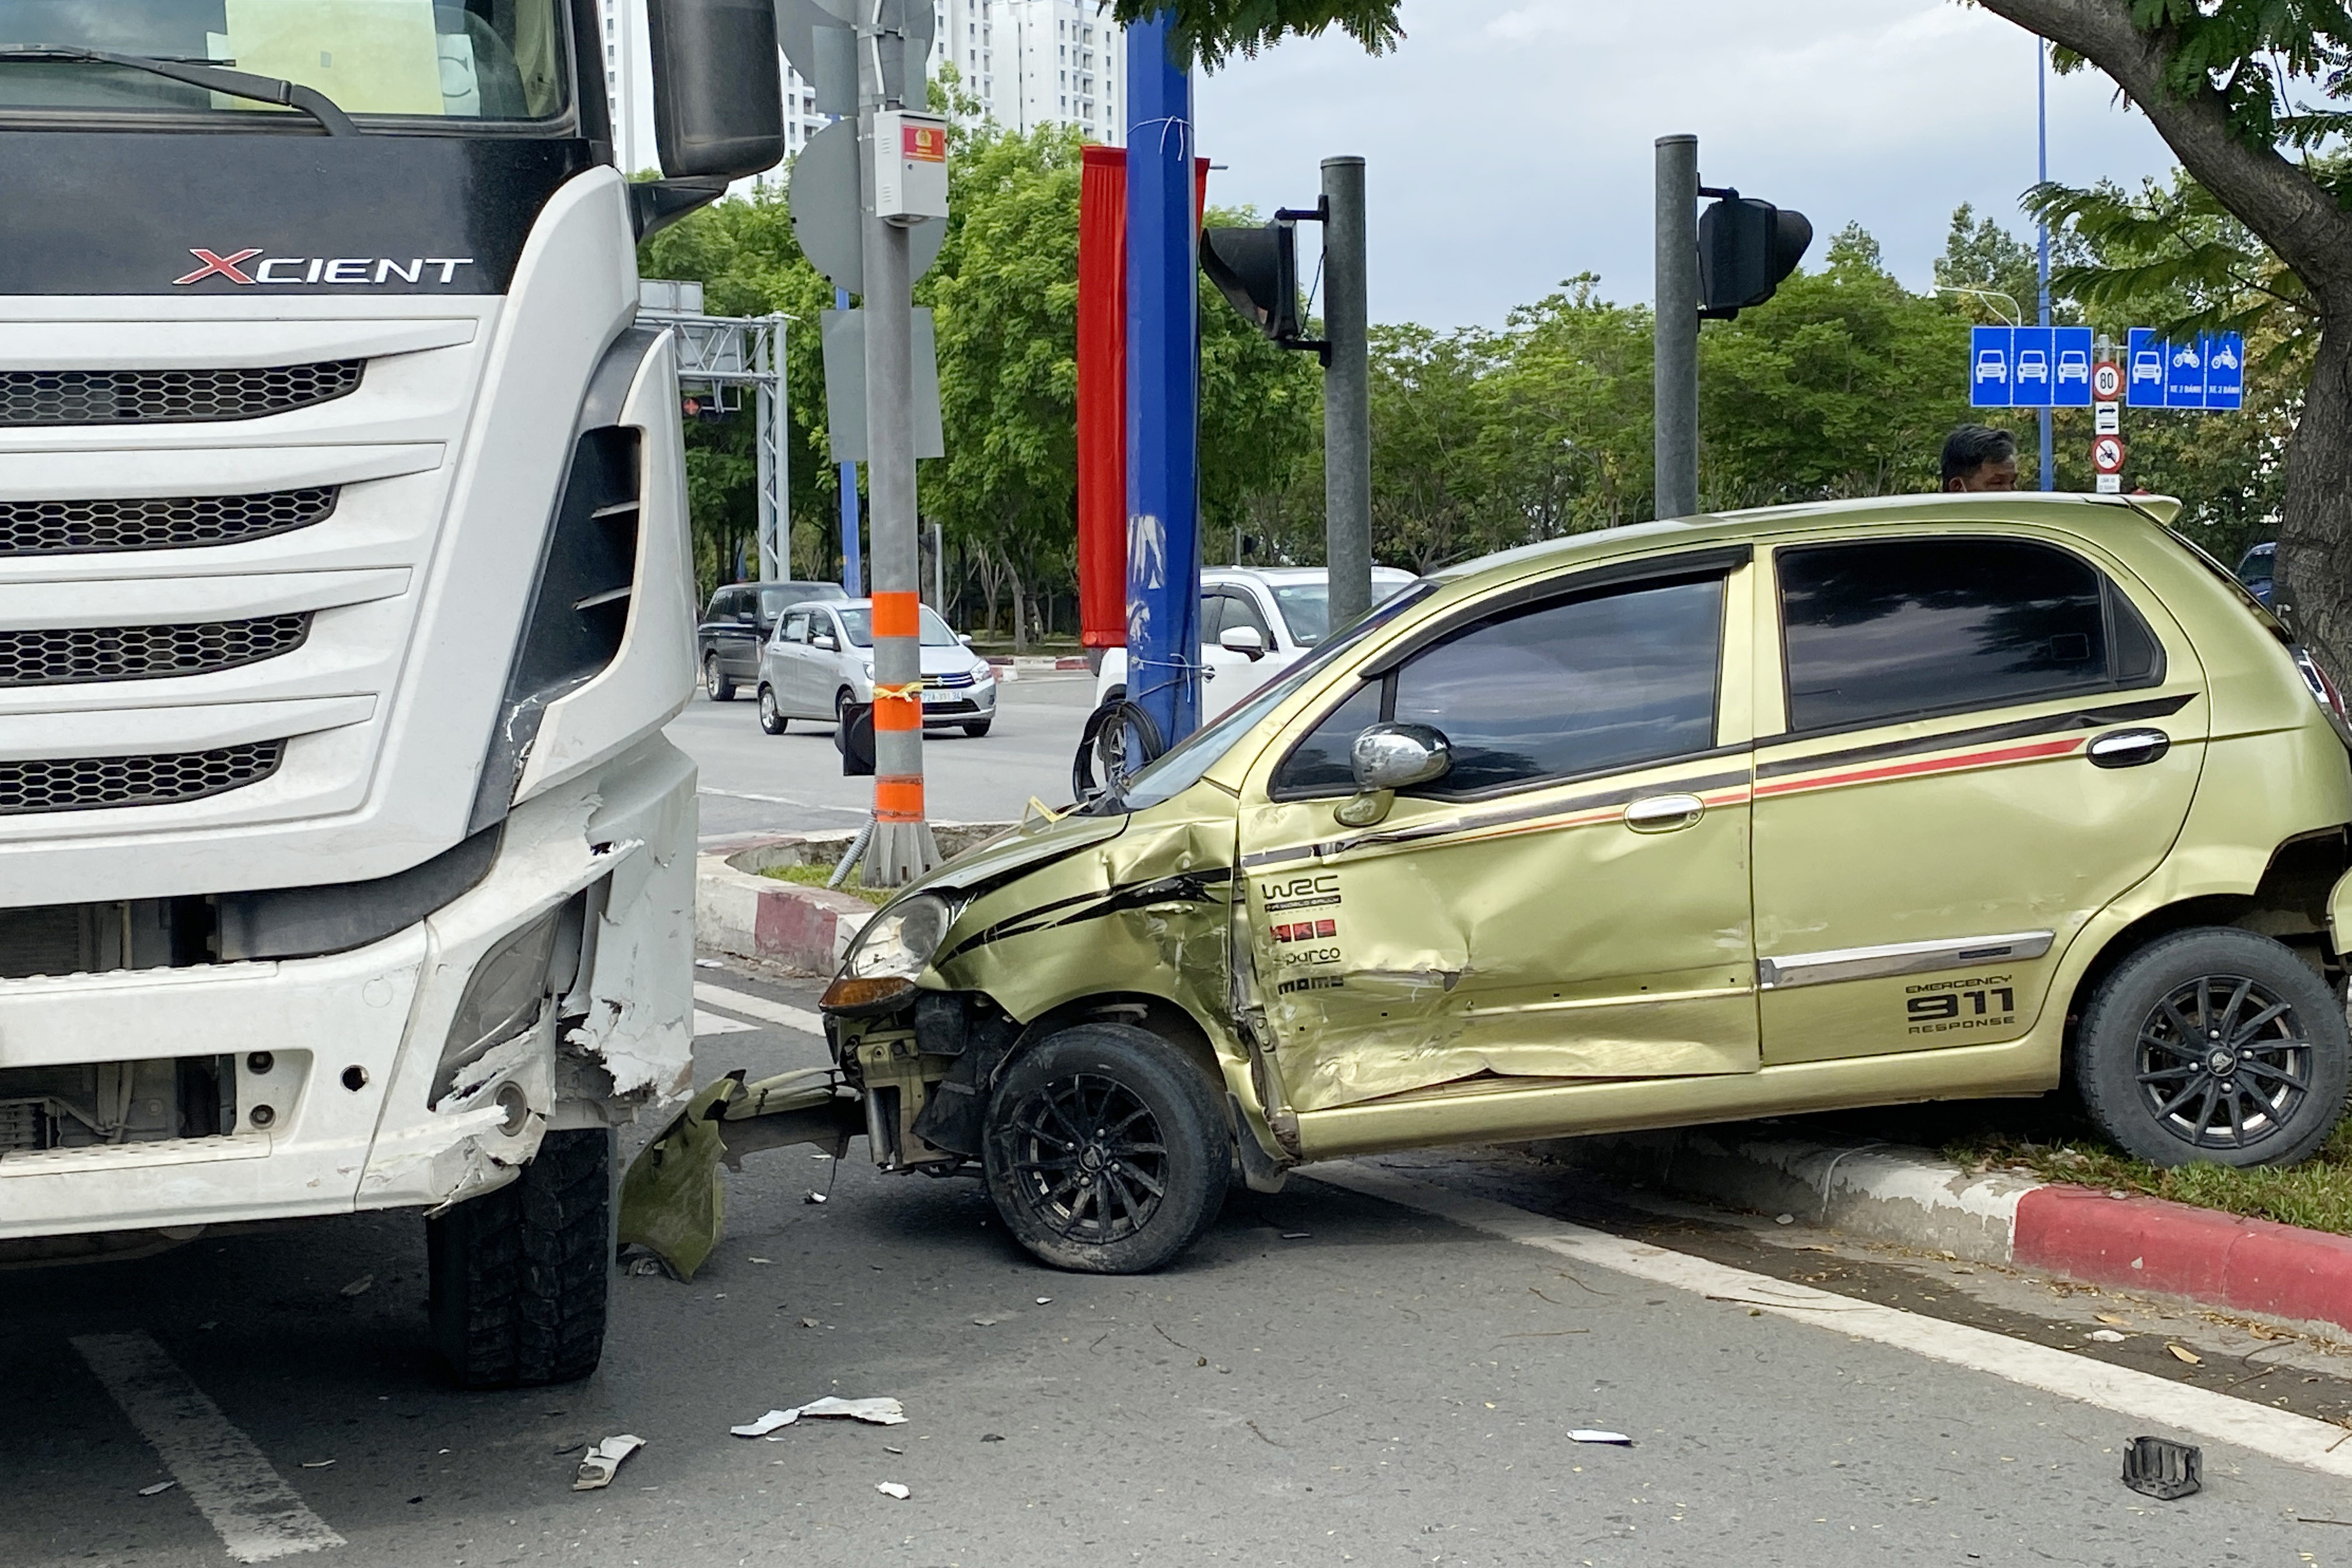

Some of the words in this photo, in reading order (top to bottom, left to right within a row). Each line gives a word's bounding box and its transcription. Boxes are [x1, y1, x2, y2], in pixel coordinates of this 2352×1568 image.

[173, 249, 474, 285] XCIENT
[2100, 373, 2113, 389] 80
[1262, 875, 1339, 900] WRC
[1906, 975, 2012, 993] EMERGENCY
[1908, 988, 2014, 1022] 911
[1909, 1016, 2015, 1034] RESPONSE
